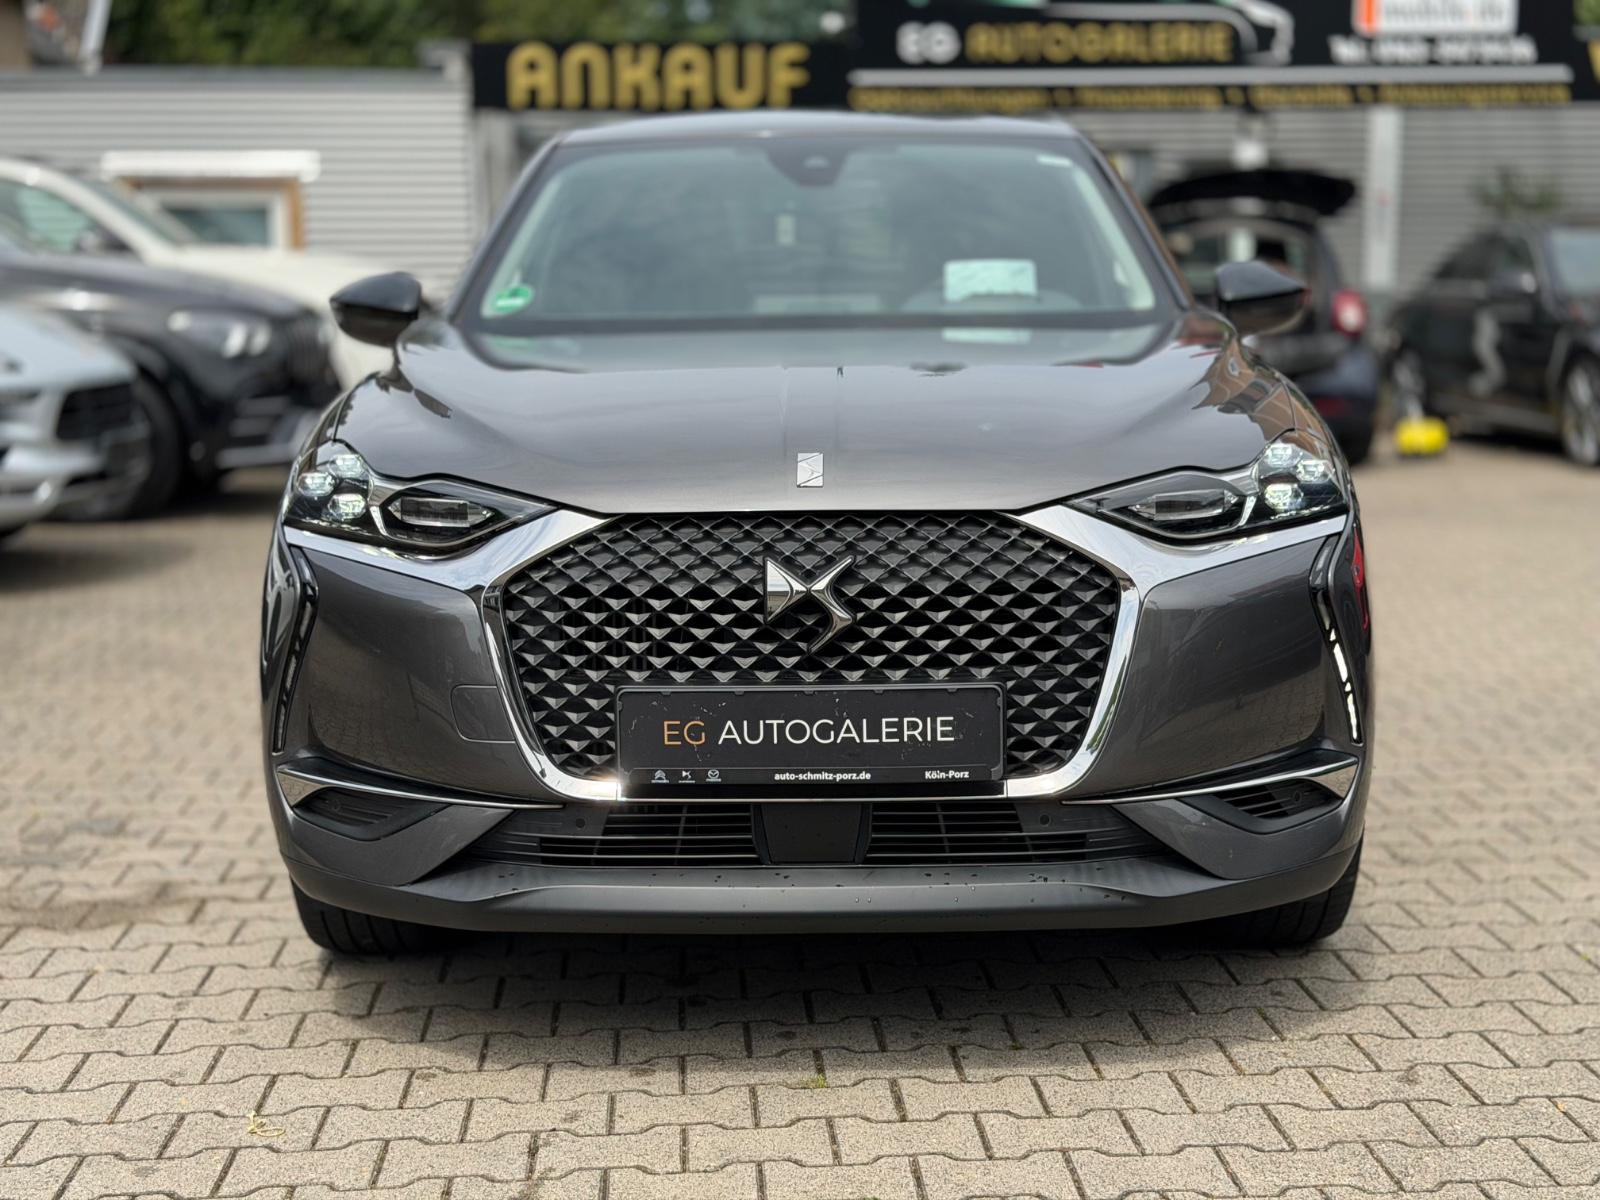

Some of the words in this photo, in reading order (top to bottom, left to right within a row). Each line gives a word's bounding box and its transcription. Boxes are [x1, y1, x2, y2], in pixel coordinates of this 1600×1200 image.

[506, 41, 810, 109] ANKAUF
[663, 720, 706, 746] EG
[717, 716, 955, 745] AUTOGALERIE
[774, 771, 872, 783] auto-schmitz-porz.de
[924, 769, 970, 781] Köln-Porz
